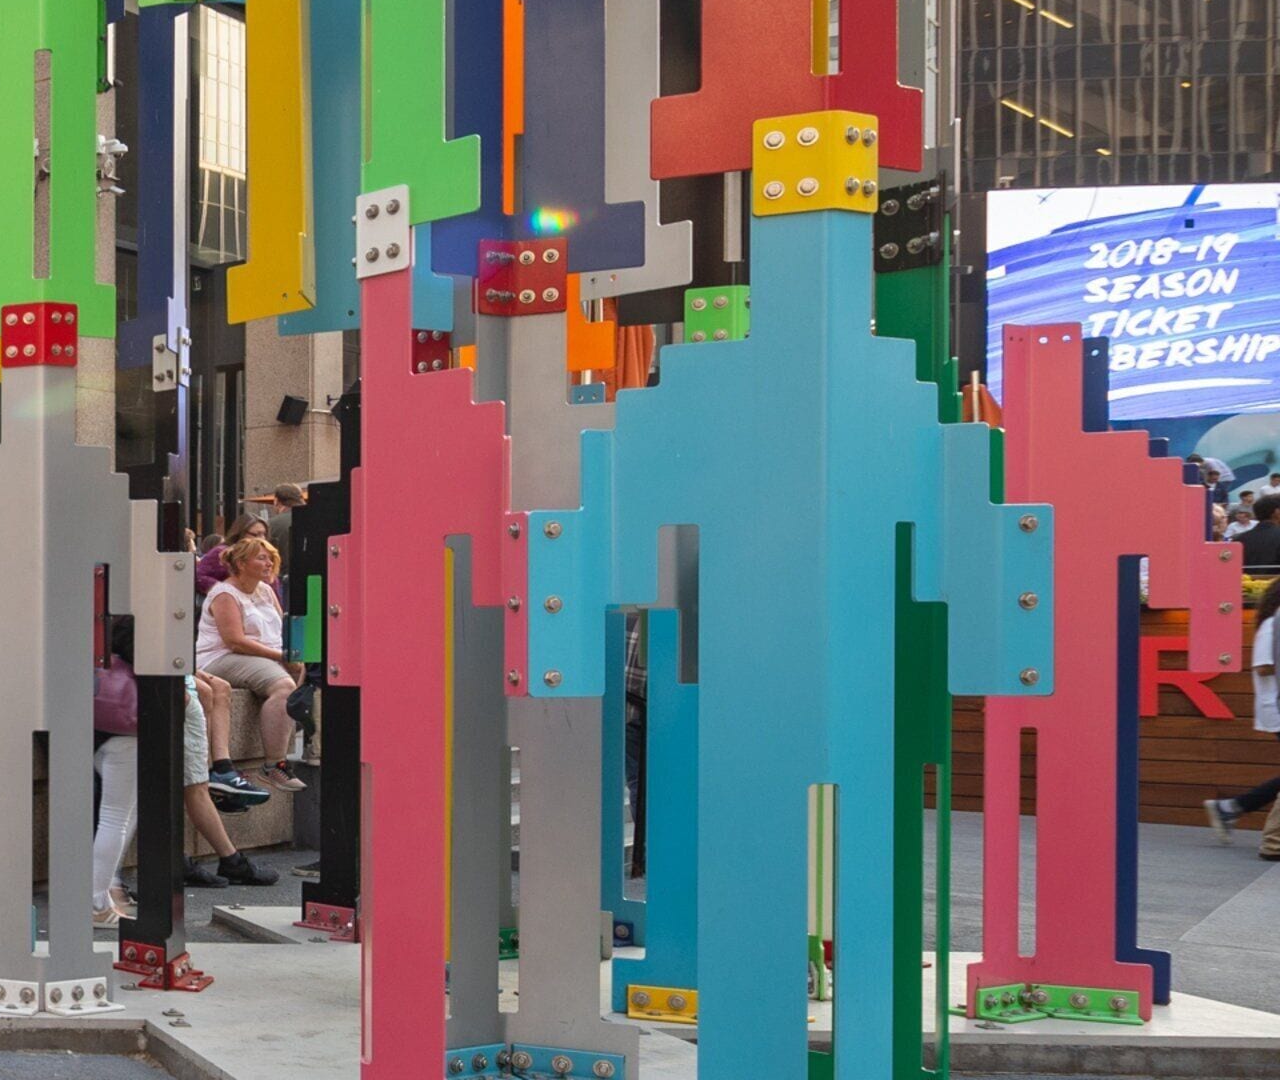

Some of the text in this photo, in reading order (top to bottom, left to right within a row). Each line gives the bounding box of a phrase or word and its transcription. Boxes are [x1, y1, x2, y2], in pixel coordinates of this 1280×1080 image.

[1084, 233, 1239, 270] 2018-19
[1083, 268, 1240, 304] SEASON
[1087, 303, 1235, 339] TICKET
[1110, 332, 1280, 372] BERSHIP
